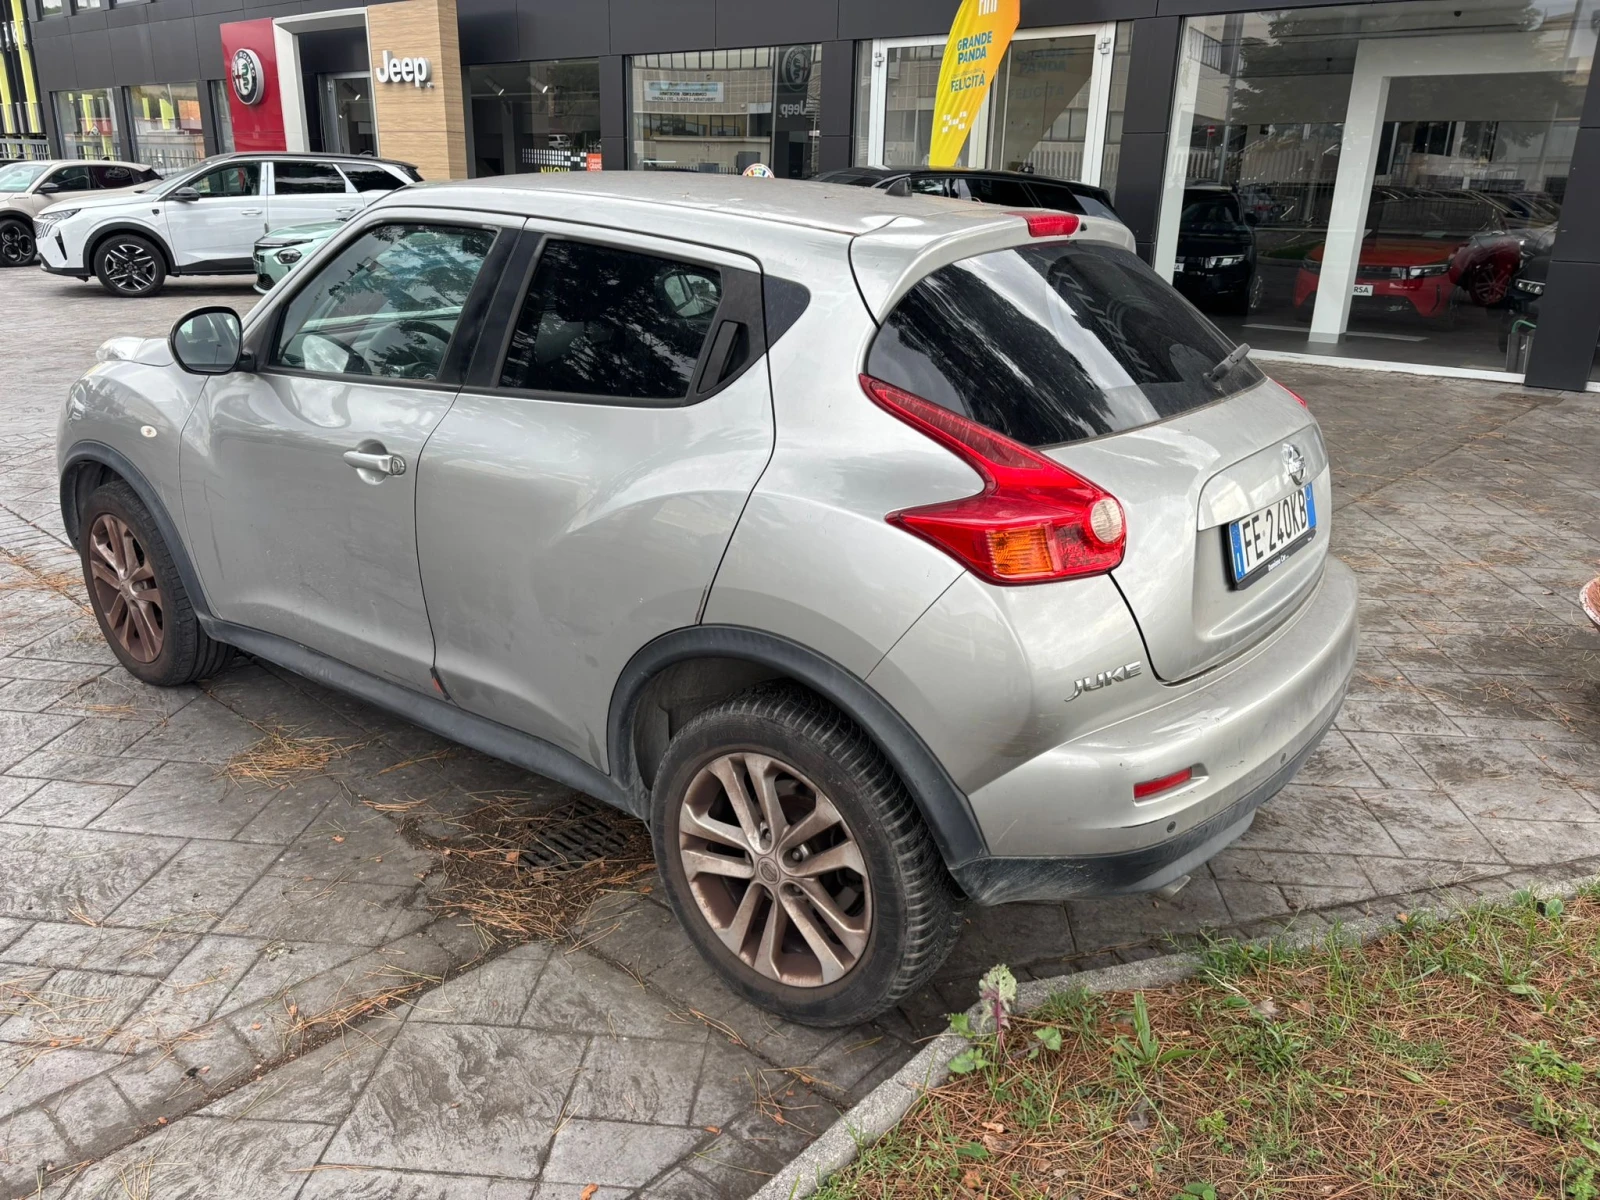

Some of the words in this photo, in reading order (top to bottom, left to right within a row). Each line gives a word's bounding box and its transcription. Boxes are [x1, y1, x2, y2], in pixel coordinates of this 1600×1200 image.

[957, 31, 993, 51] GRANDE
[958, 46, 987, 65] PANDA
[375, 50, 431, 88] Jeep
[951, 70, 986, 92] FELICITÀ
[1242, 514, 1264, 567] FE
[1266, 489, 1307, 552] 240KB
[1063, 661, 1142, 703] JUKE
